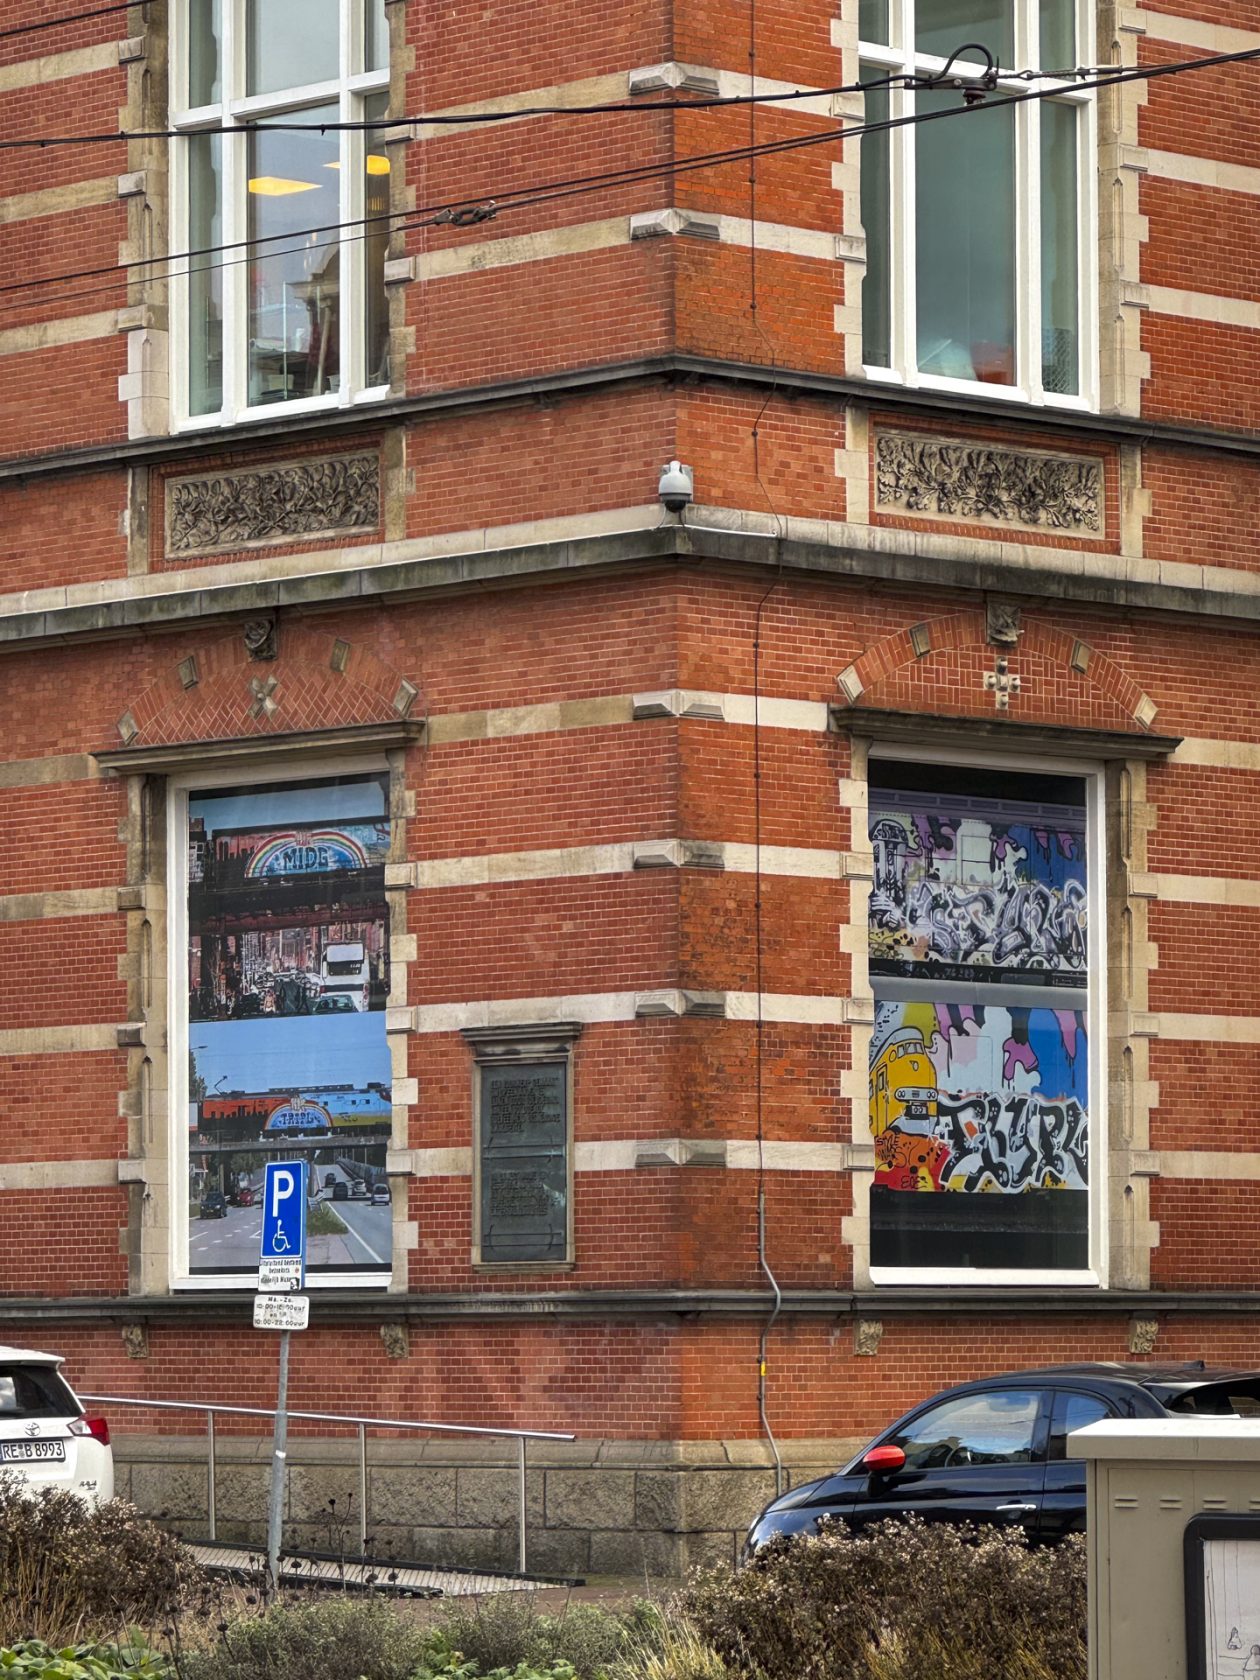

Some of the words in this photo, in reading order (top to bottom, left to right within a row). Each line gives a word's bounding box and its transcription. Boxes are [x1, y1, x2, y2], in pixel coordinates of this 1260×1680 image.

[272, 1170, 294, 1217] P
[2, 1444, 19, 1459] RE
[24, 1443, 33, 1457] B
[35, 1442, 62, 1457] 8993
